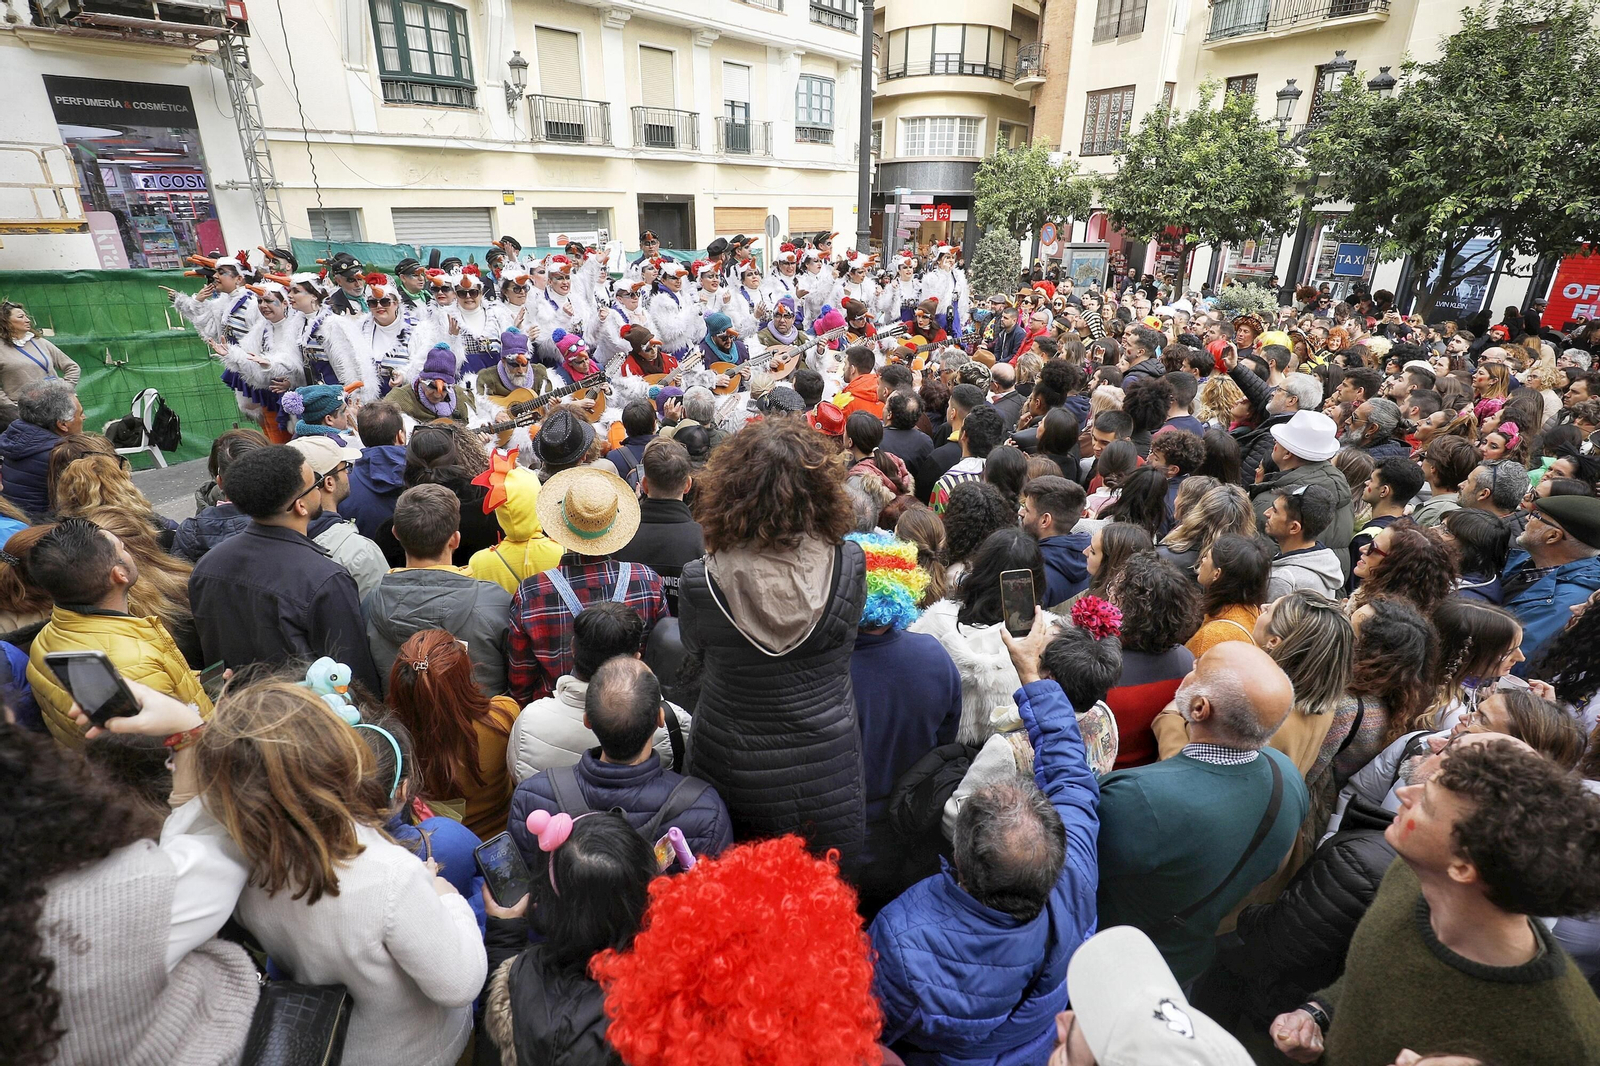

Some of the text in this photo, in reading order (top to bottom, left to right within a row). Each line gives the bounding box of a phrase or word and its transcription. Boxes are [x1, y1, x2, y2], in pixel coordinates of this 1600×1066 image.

[54, 95, 189, 112] PERFUMERÍA & COSMÉTICA
[93, 228, 121, 269] kra
[1338, 254, 1366, 265] TAXI
[1562, 283, 1600, 301] OF
[1450, 301, 1468, 310] KLEIN
[491, 848, 506, 861] 4:45
